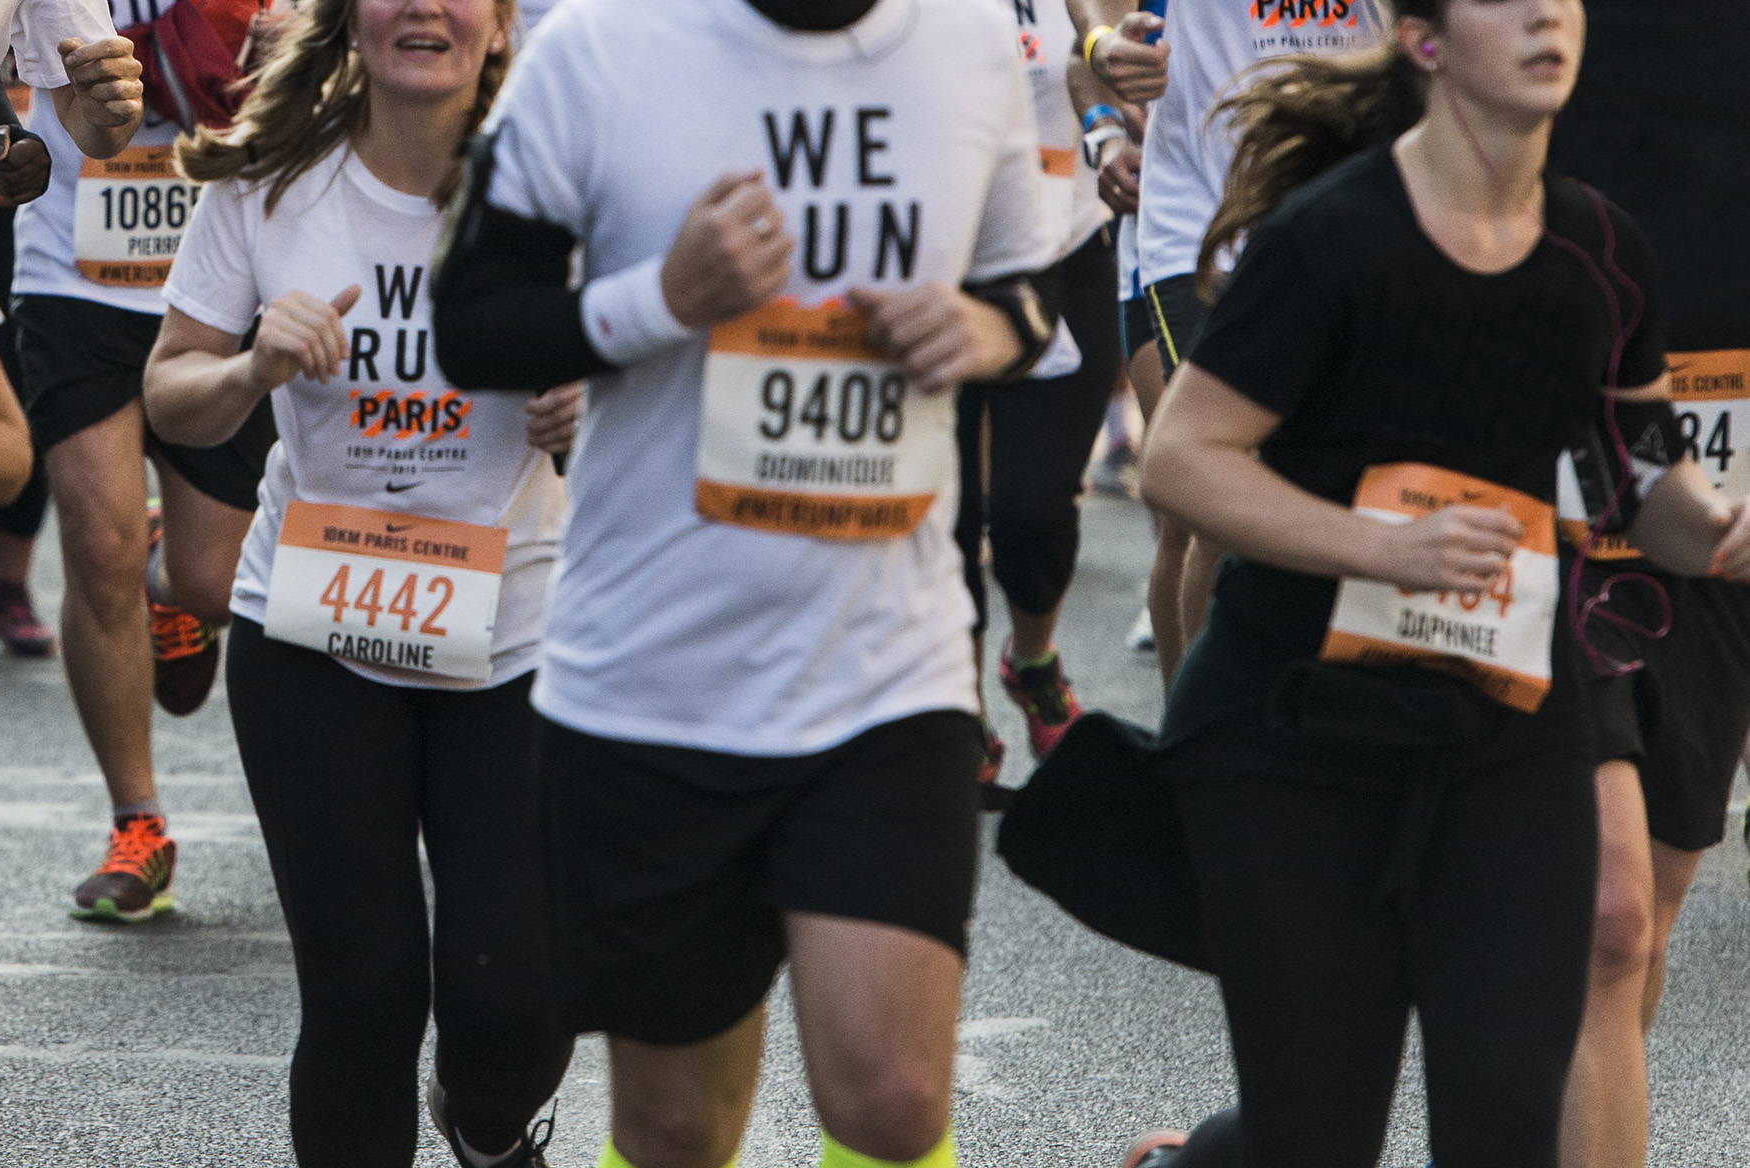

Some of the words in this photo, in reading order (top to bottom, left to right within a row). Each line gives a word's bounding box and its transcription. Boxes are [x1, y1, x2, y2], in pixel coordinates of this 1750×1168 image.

[762, 107, 895, 190] WE
[803, 202, 922, 281] UN
[375, 264, 425, 321] W
[348, 327, 429, 383] RU
[357, 397, 464, 434] PARIS
[758, 371, 905, 444] 9408
[323, 526, 360, 547] 10KM
[364, 533, 407, 554] PARIS
[412, 539, 469, 562] CENTRE
[319, 563, 455, 638] 4442
[327, 631, 435, 670] CAROLINE
